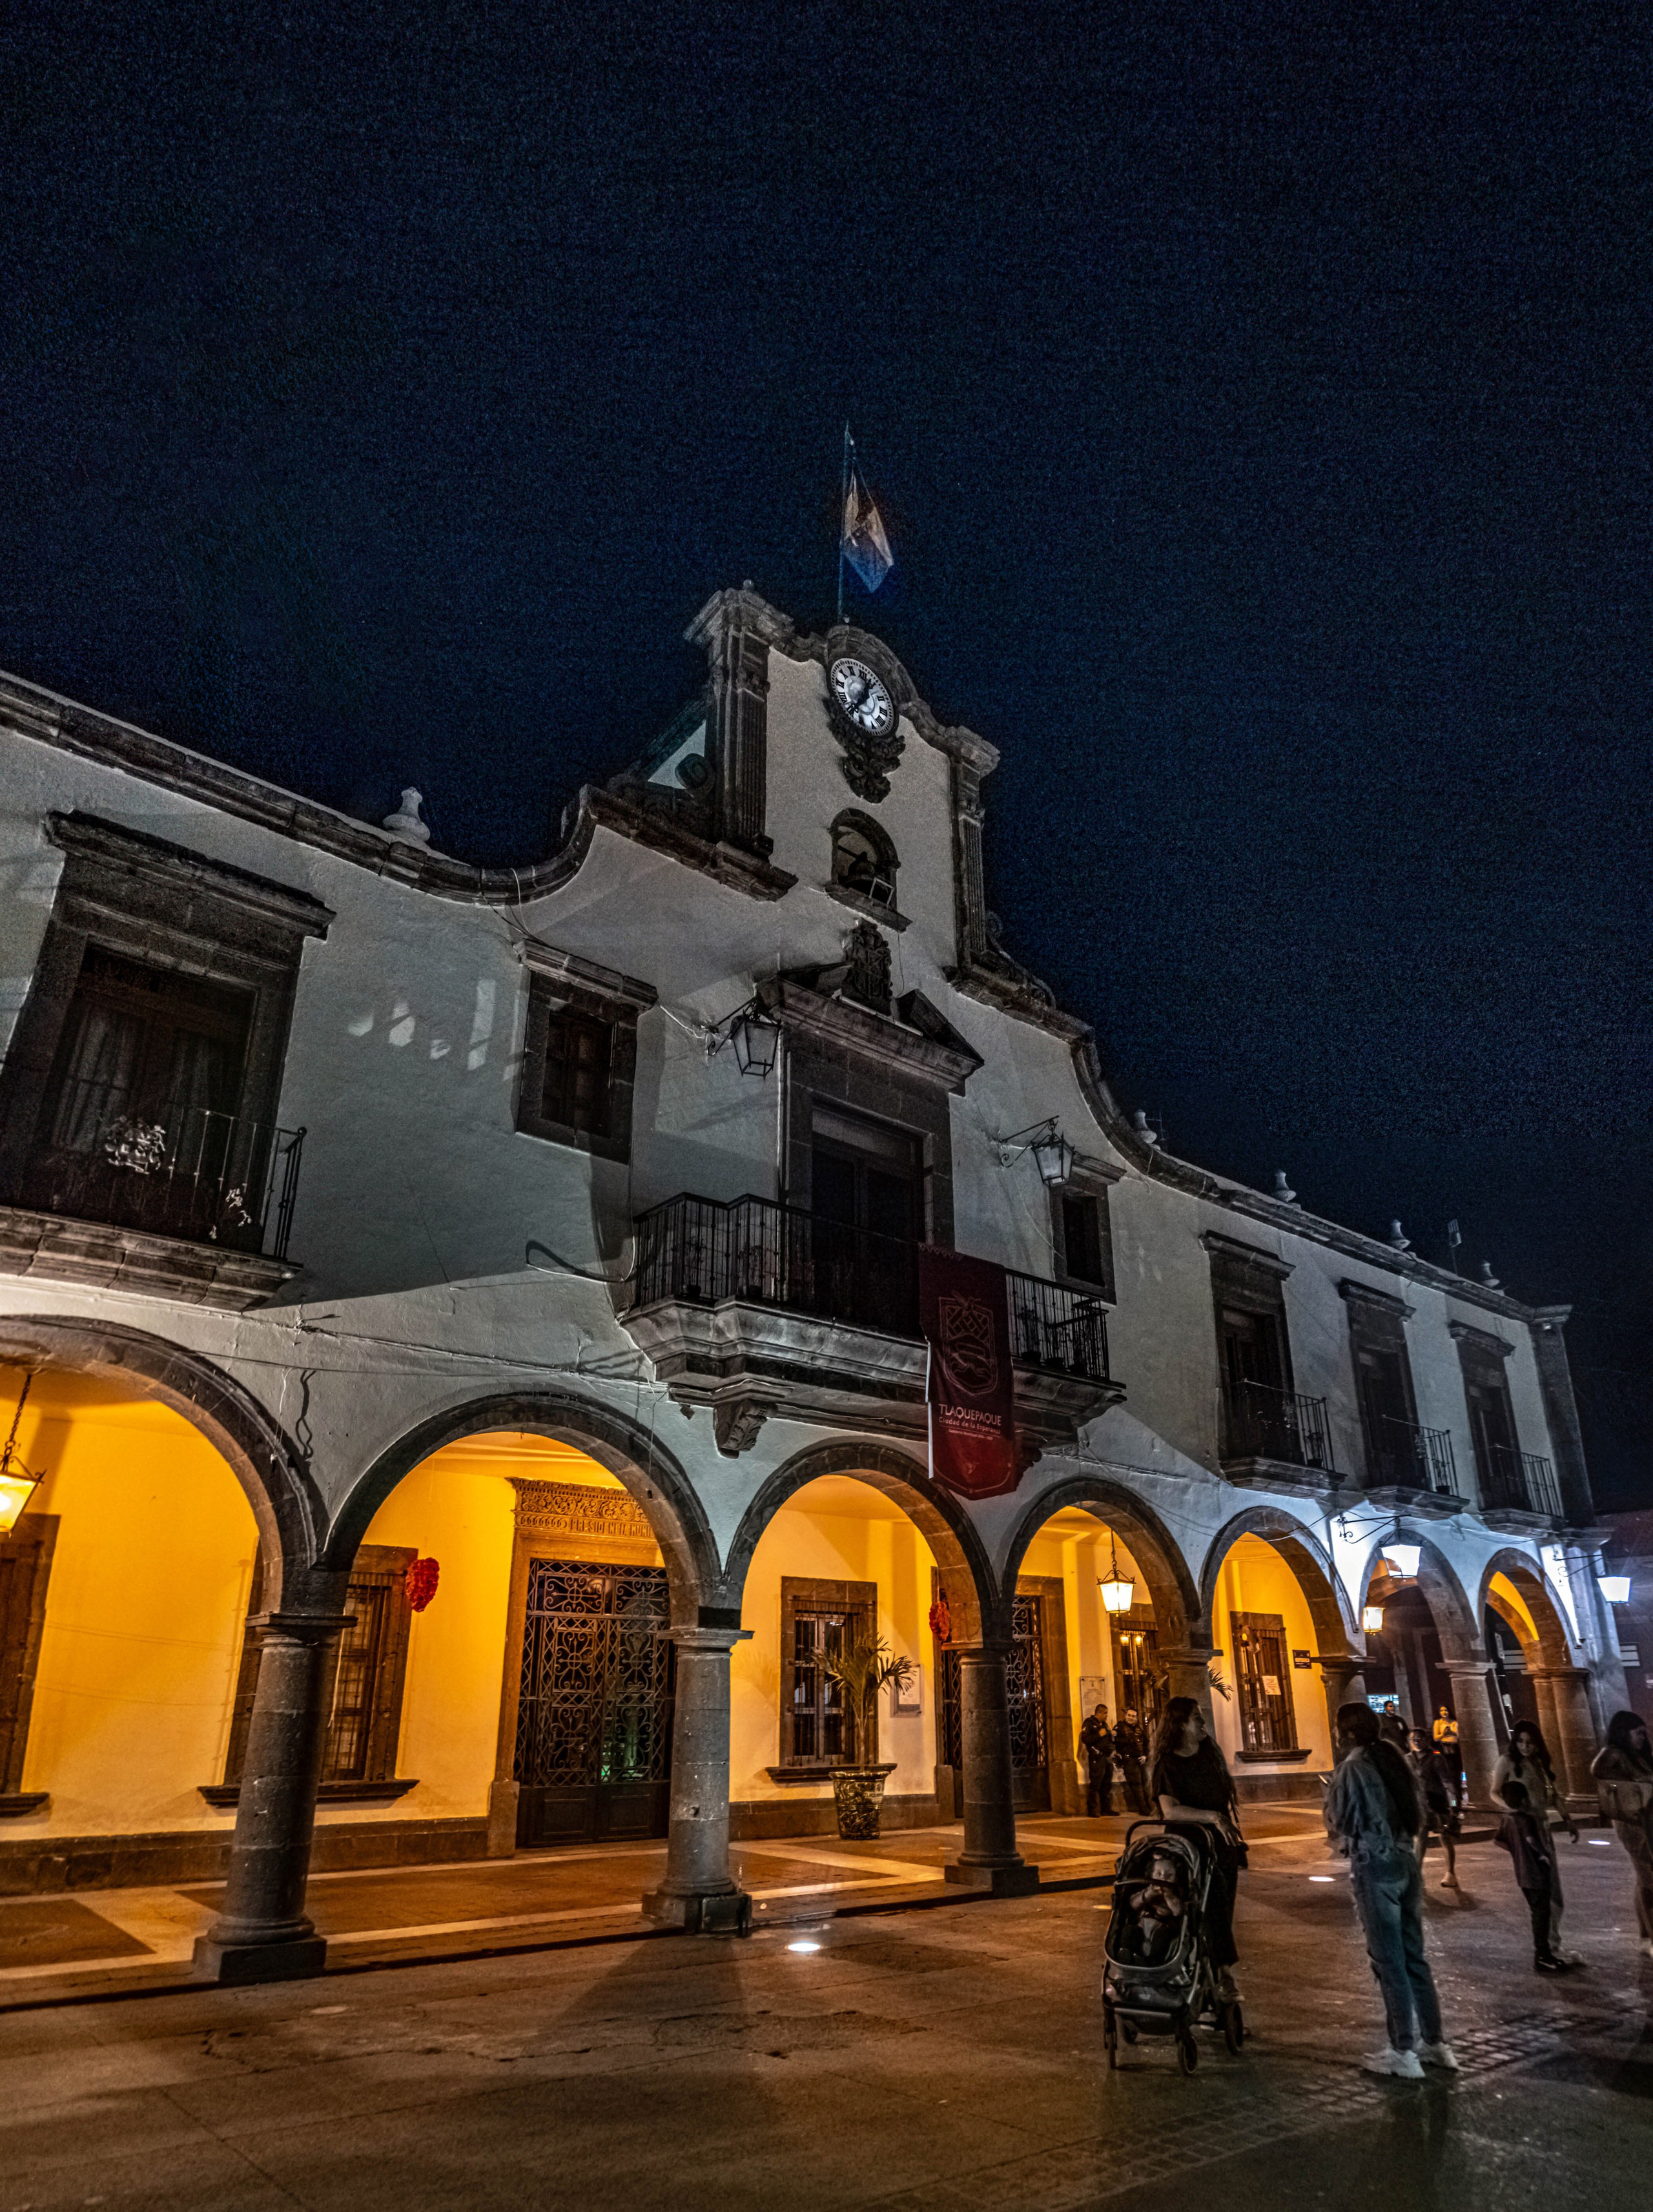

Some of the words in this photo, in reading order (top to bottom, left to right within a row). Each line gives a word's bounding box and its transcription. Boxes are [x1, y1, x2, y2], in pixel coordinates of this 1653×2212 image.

[879, 706, 888, 718] III
[938, 1404, 1001, 1426] TLAQUEPAQUE
[939, 1417, 960, 1426] Ciudad
